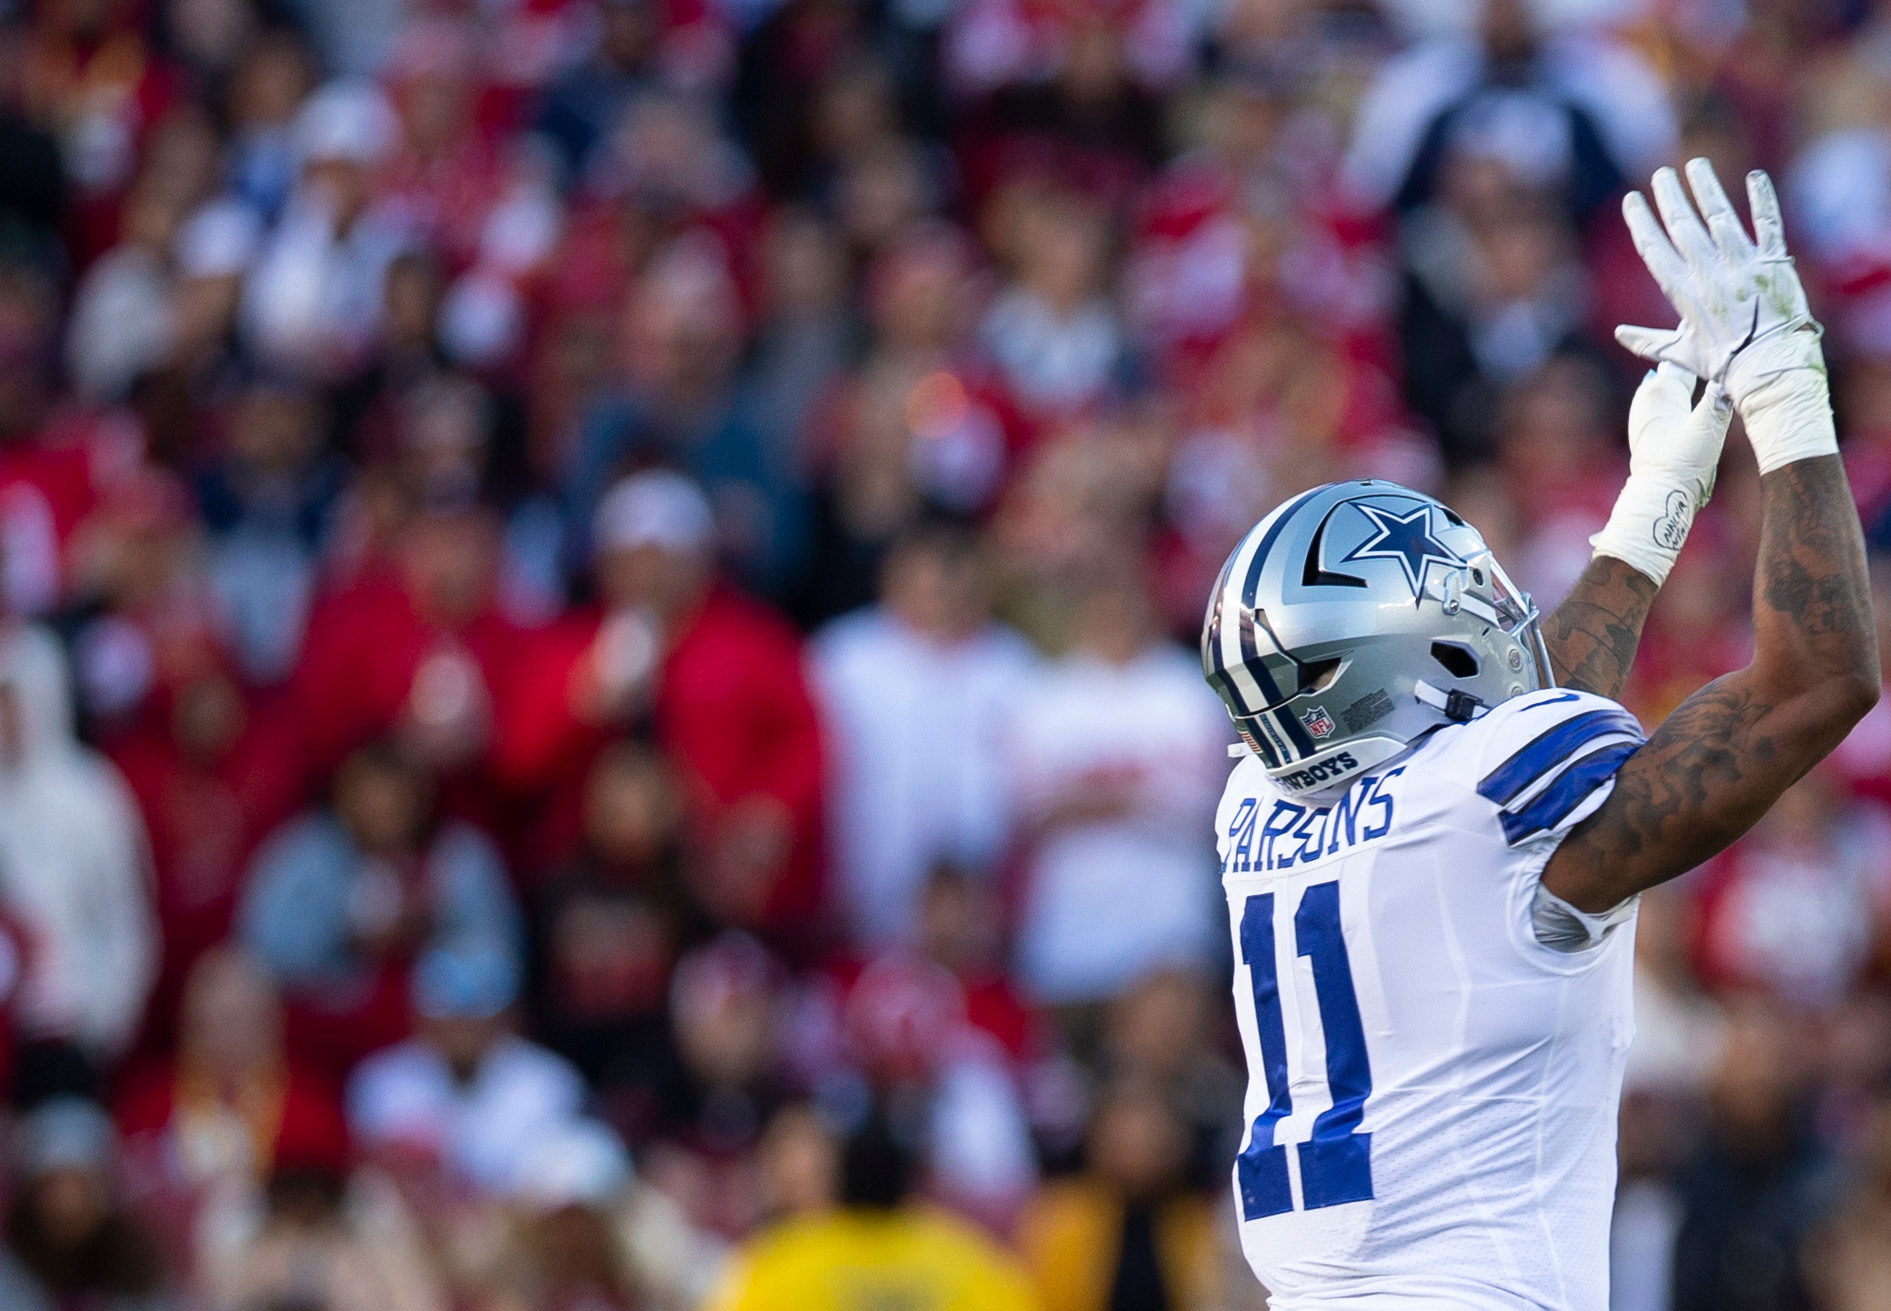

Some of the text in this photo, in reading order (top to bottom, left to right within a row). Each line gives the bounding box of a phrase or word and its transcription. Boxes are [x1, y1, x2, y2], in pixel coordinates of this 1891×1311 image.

[1309, 718, 1333, 735] NFL
[1220, 765, 1407, 874] PARSONS
[1237, 880, 1375, 1222] 11
